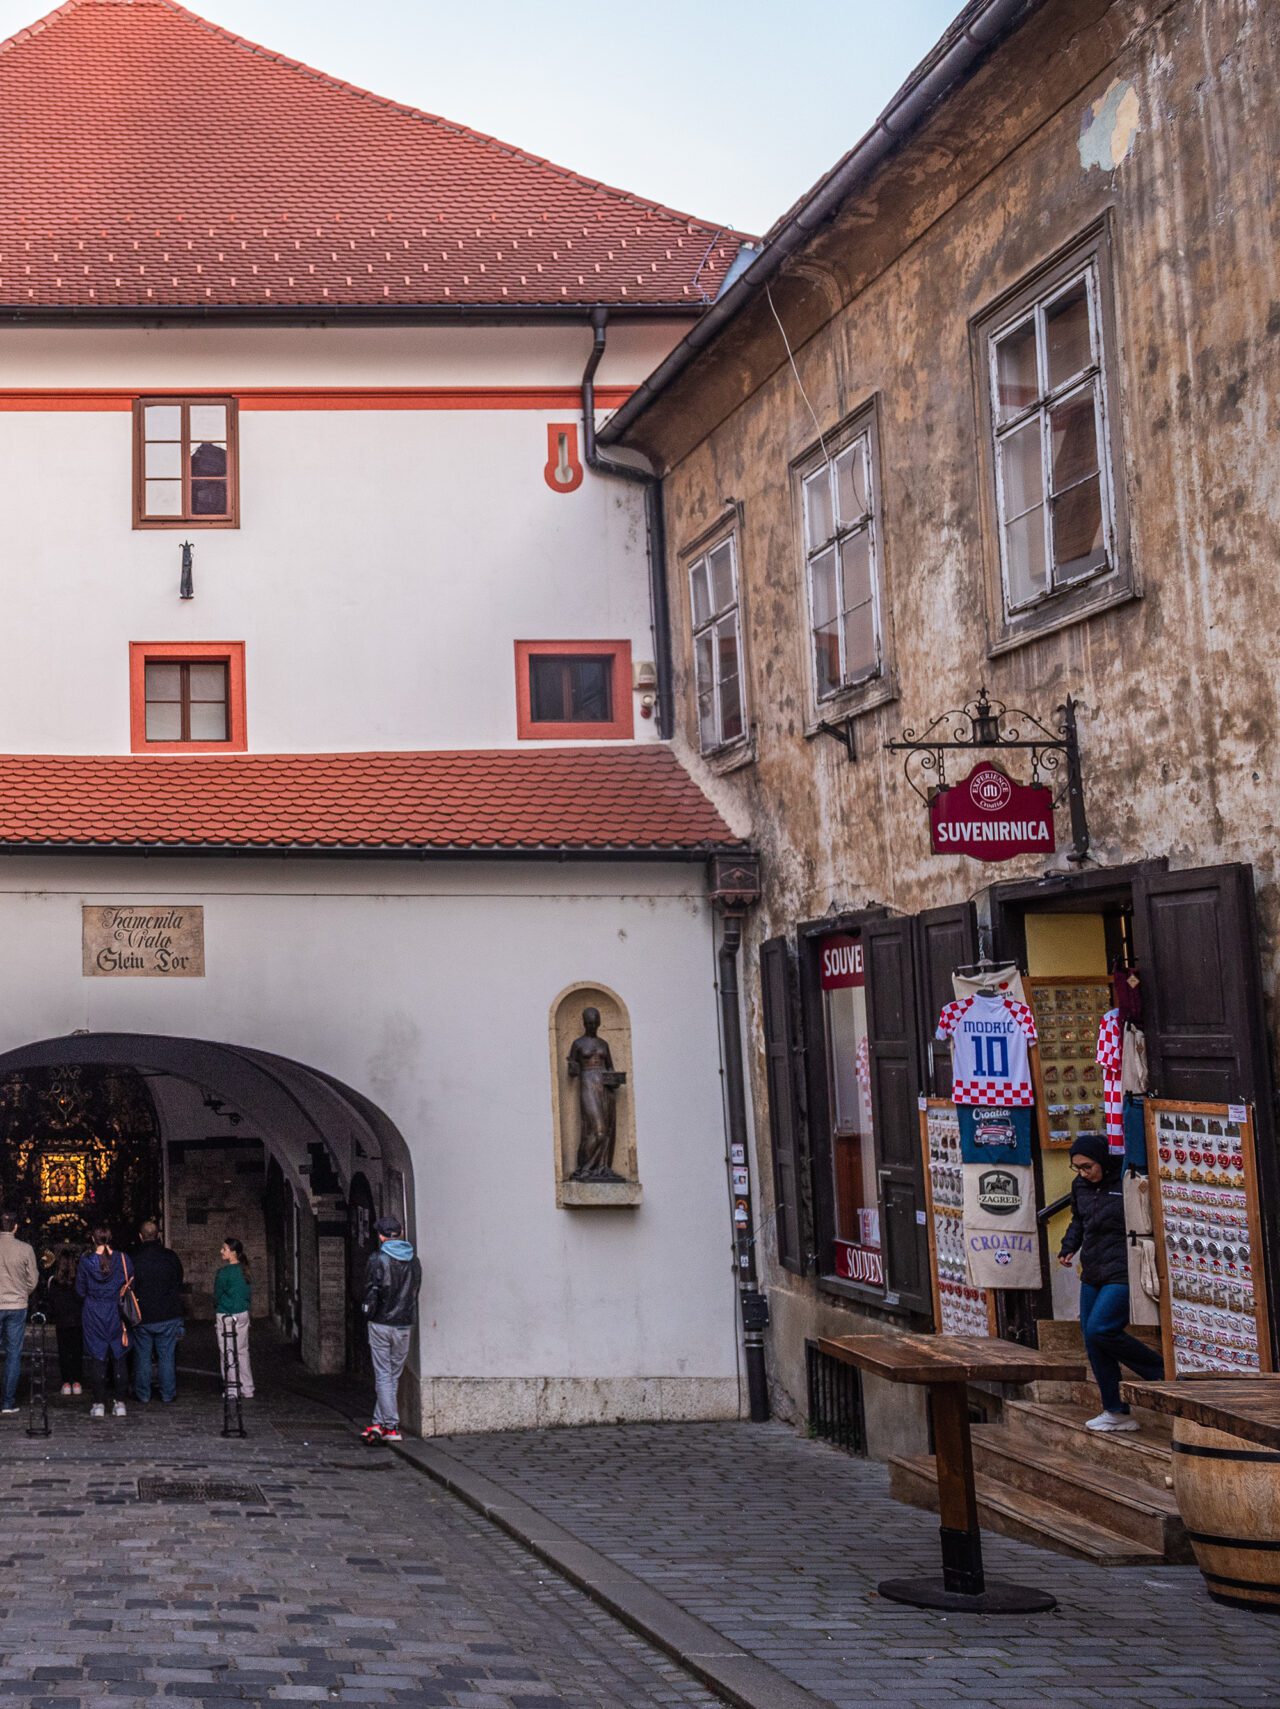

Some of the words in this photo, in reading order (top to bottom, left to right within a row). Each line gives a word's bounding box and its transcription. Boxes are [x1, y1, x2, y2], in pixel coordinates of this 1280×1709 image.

[972, 772, 1009, 793] EXPERIENCE
[980, 800, 1003, 809] Croatia
[937, 821, 1050, 842] SUVENIRNICA
[154, 949, 190, 972] Tor
[824, 944, 864, 977] SOUVE
[963, 1020, 1014, 1034] MODRIĆ
[971, 1036, 1009, 1077] 10
[972, 1107, 1011, 1120] Croatia
[981, 1194, 1019, 1205] ZAGREB
[970, 1234, 1032, 1253] CROATIA
